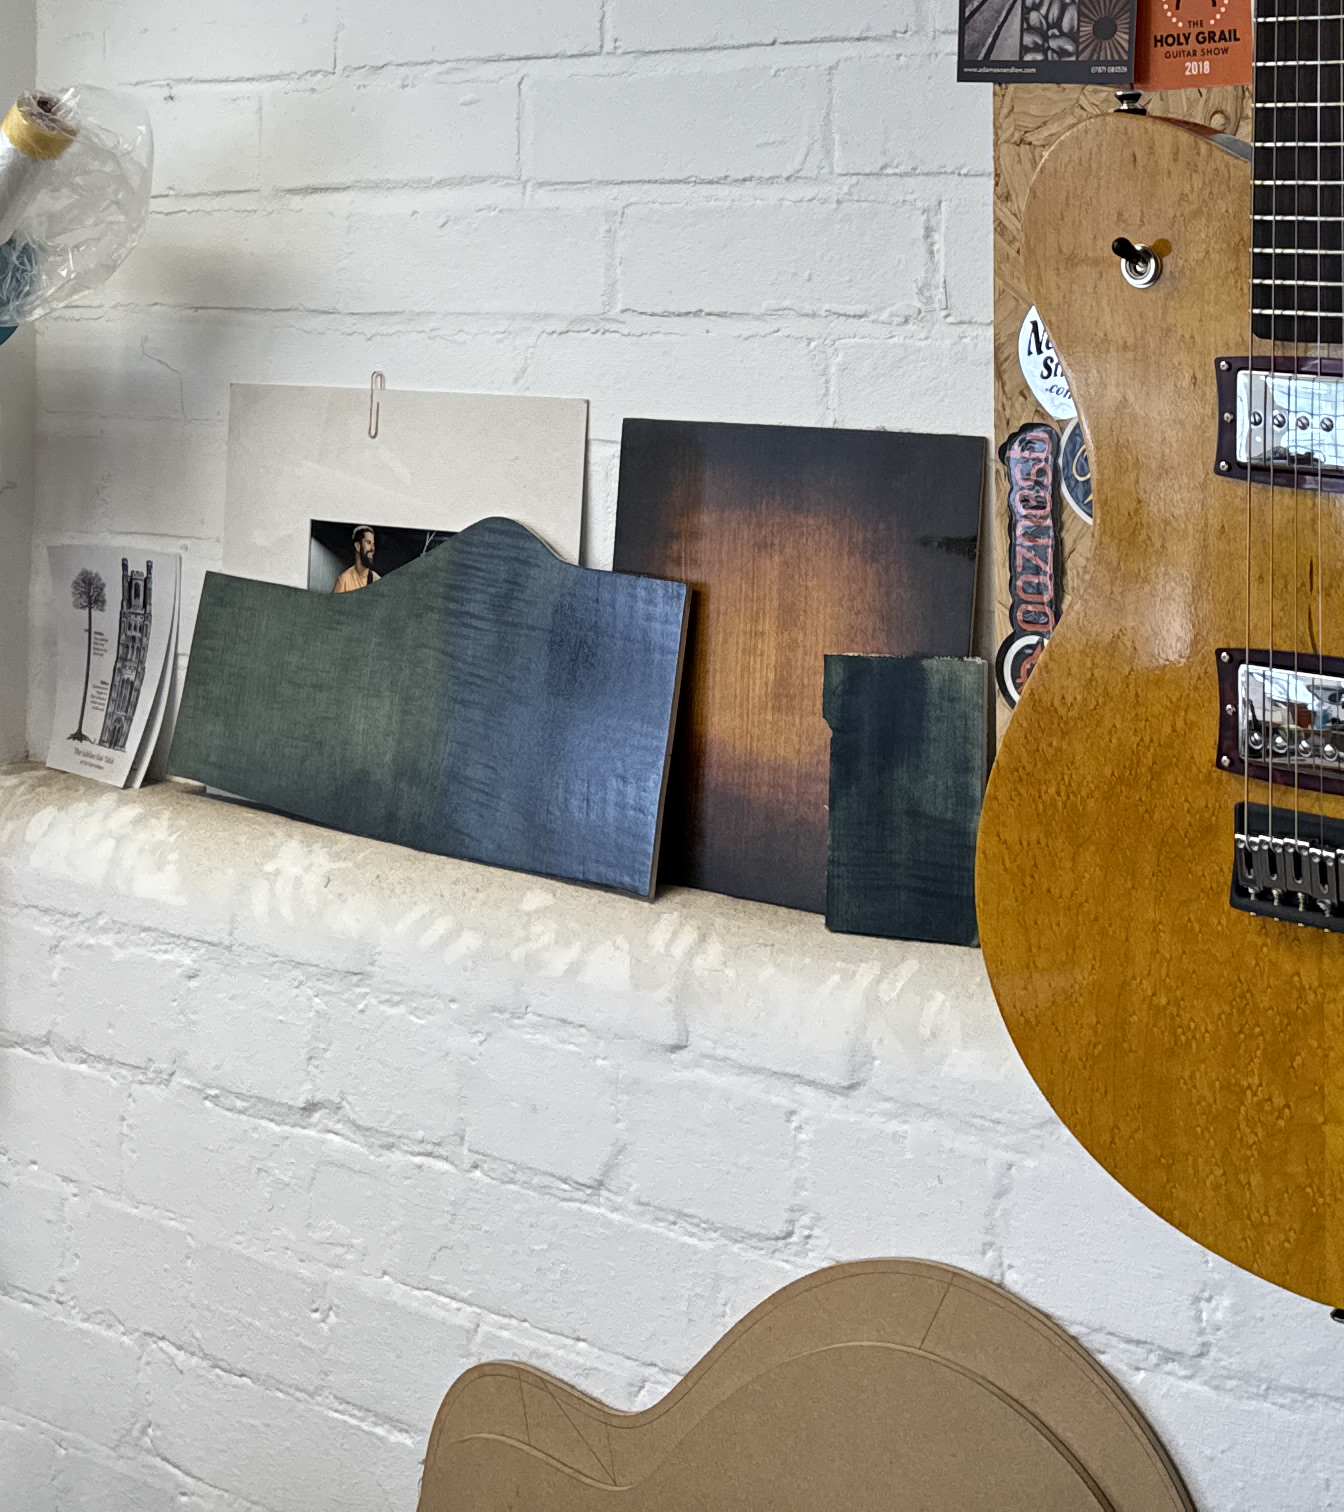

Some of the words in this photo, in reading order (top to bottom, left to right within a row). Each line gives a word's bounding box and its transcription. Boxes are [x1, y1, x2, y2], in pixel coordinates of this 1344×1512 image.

[1187, 19, 1204, 28] THE
[1153, 32, 1193, 49] HOLY
[1195, 29, 1241, 44] GRAIL
[1164, 49, 1198, 60] GUITAR
[1200, 46, 1230, 58] SHOW
[1184, 61, 1211, 76] 2018
